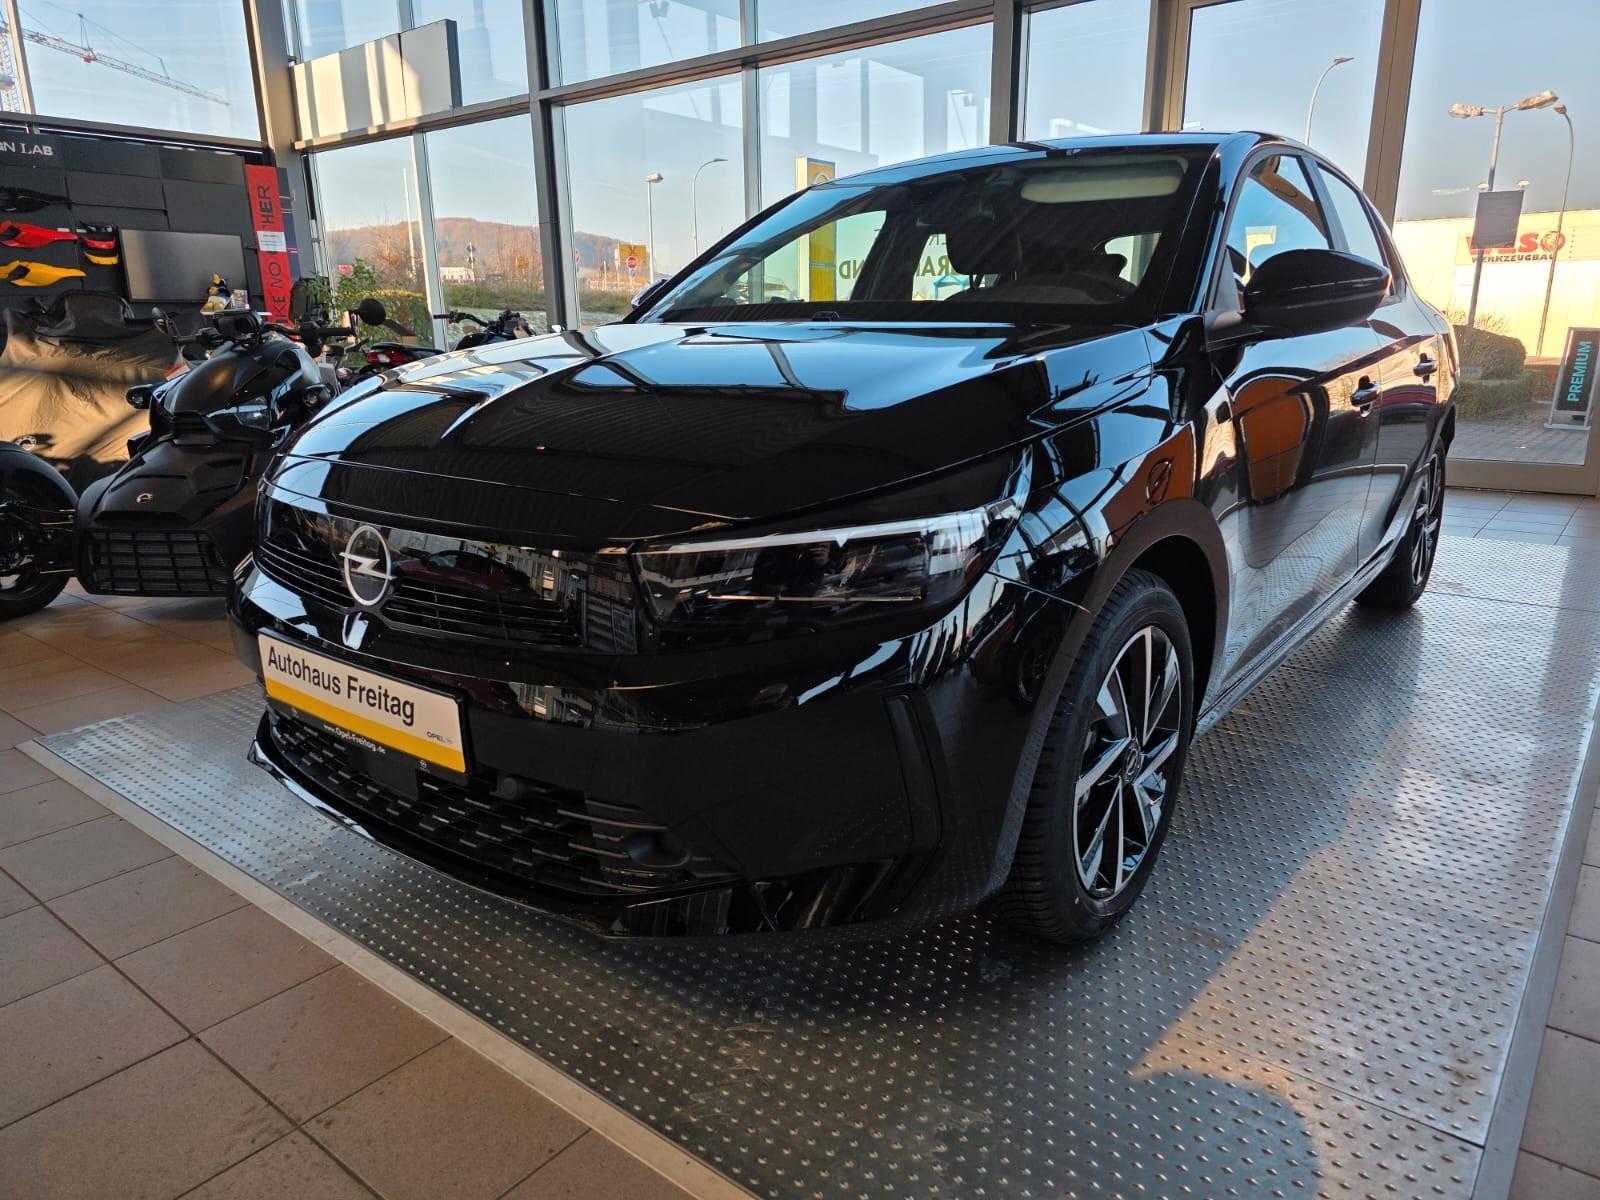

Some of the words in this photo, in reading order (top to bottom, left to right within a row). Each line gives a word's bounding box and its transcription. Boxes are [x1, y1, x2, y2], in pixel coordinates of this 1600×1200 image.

[19, 142, 54, 156] LAB
[268, 261, 284, 289] NO
[1567, 341, 1592, 401] PREMIUM
[268, 646, 341, 695] Autohaus
[347, 675, 415, 727] Freitag
